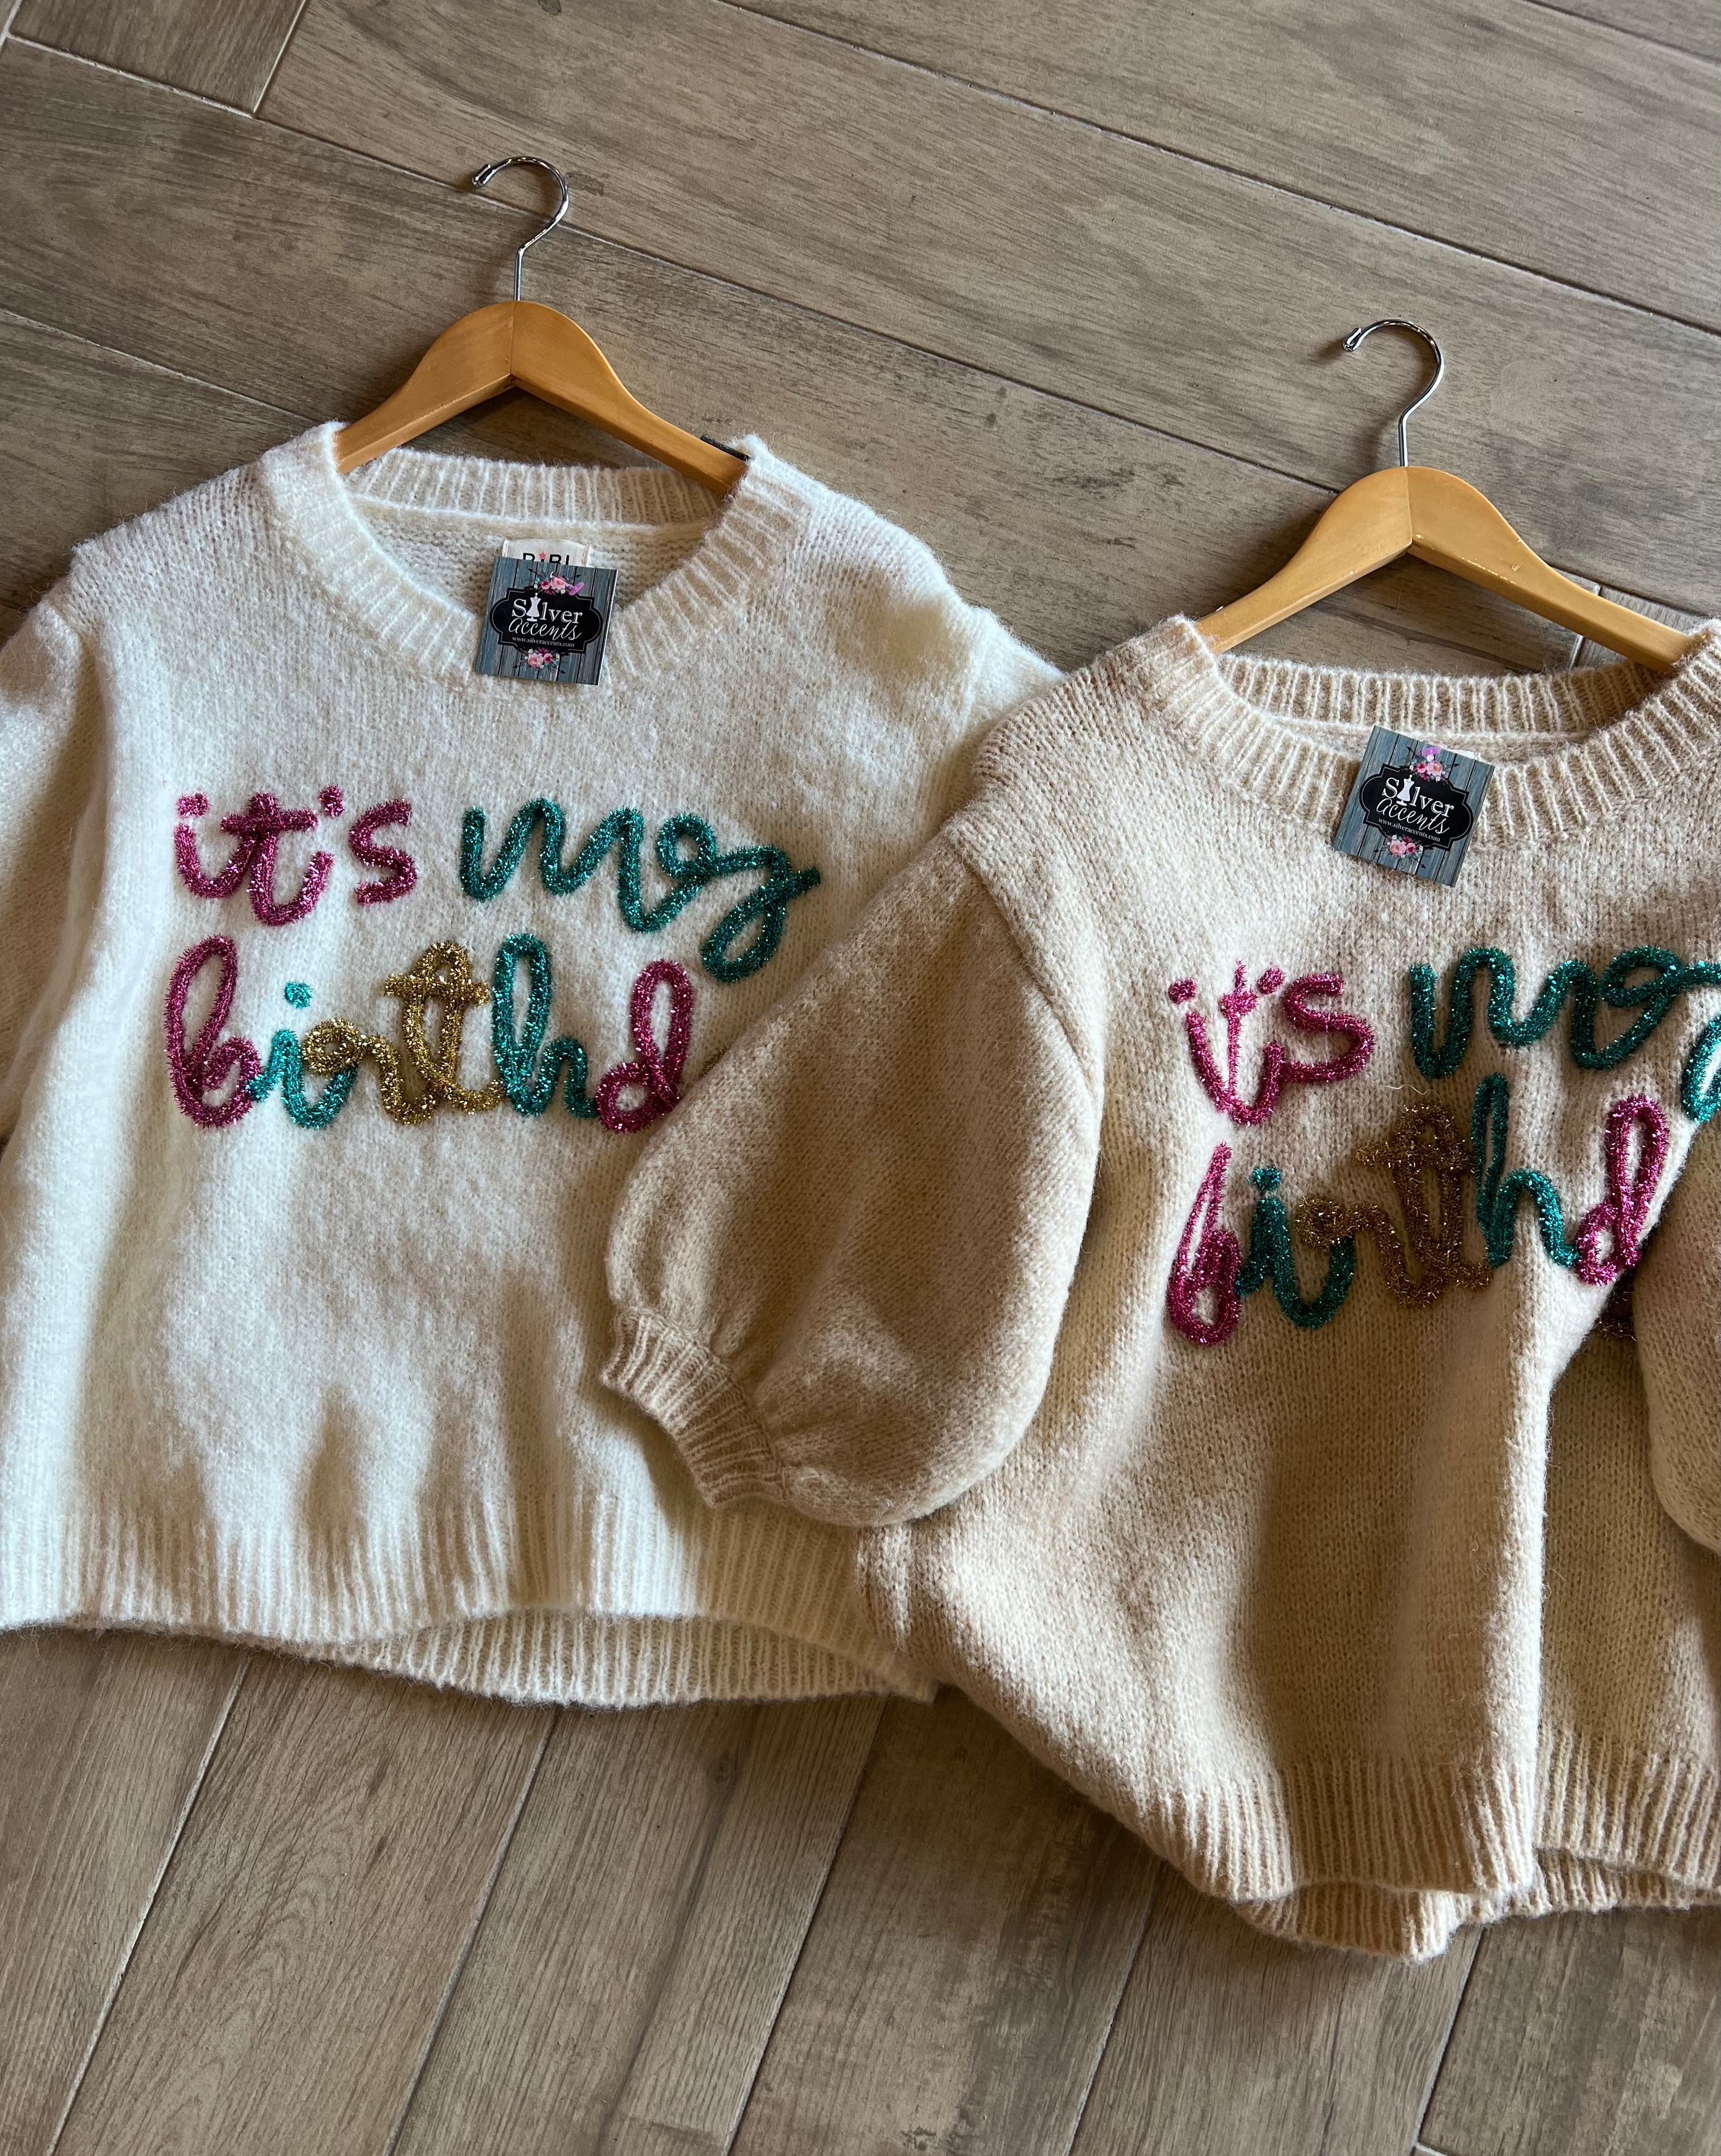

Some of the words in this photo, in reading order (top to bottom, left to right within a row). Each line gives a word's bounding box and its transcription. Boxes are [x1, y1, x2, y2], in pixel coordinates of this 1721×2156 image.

[512, 593, 583, 623] Silver
[512, 636, 575, 648] www.silveraccents.com
[1378, 818, 1441, 842] www.silveraccents.com
[1381, 774, 1454, 817] Silver
[174, 786, 418, 927] it's
[459, 798, 820, 984] my
[163, 934, 695, 1133] birthd
[1168, 960, 1375, 1126] it's
[1167, 1072, 1670, 1346] birthd
